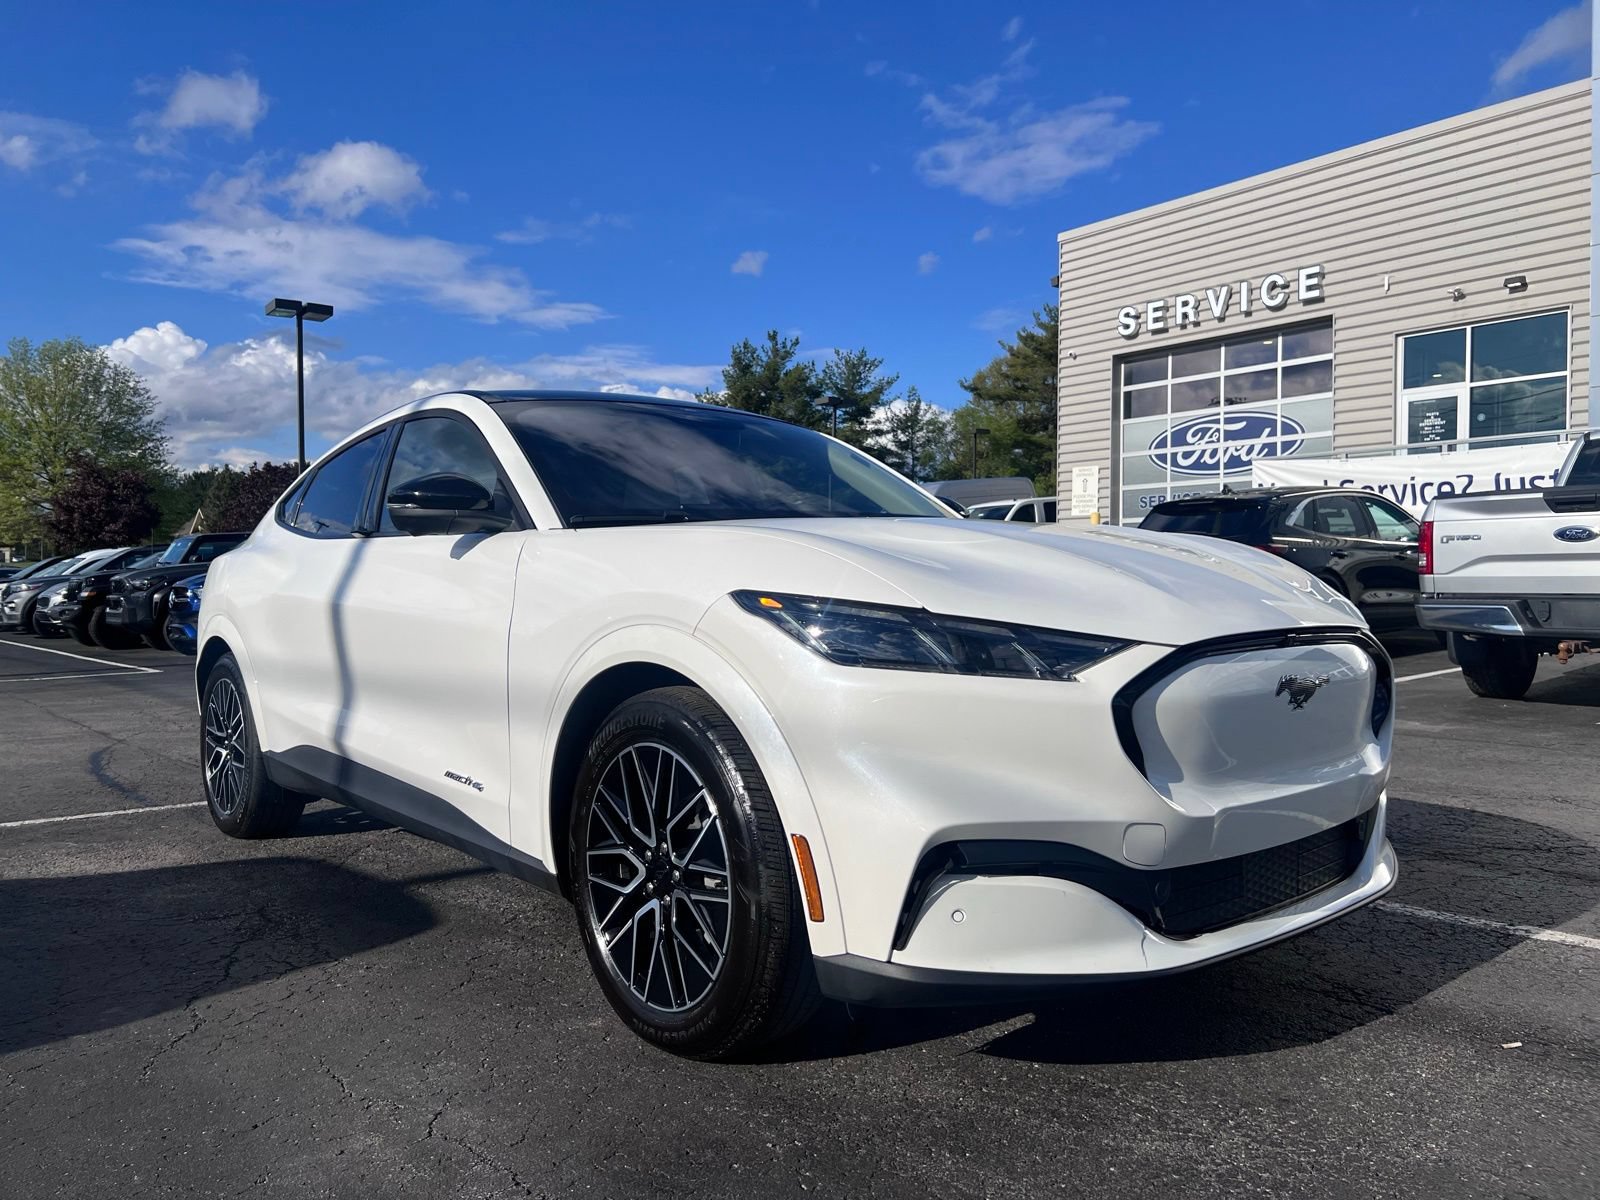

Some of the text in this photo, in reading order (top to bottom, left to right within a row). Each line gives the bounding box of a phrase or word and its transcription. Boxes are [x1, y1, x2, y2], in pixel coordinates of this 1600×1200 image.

[1117, 264, 1324, 339] SERVICE
[1176, 421, 1272, 467] Ford
[1564, 528, 1589, 539] Ford
